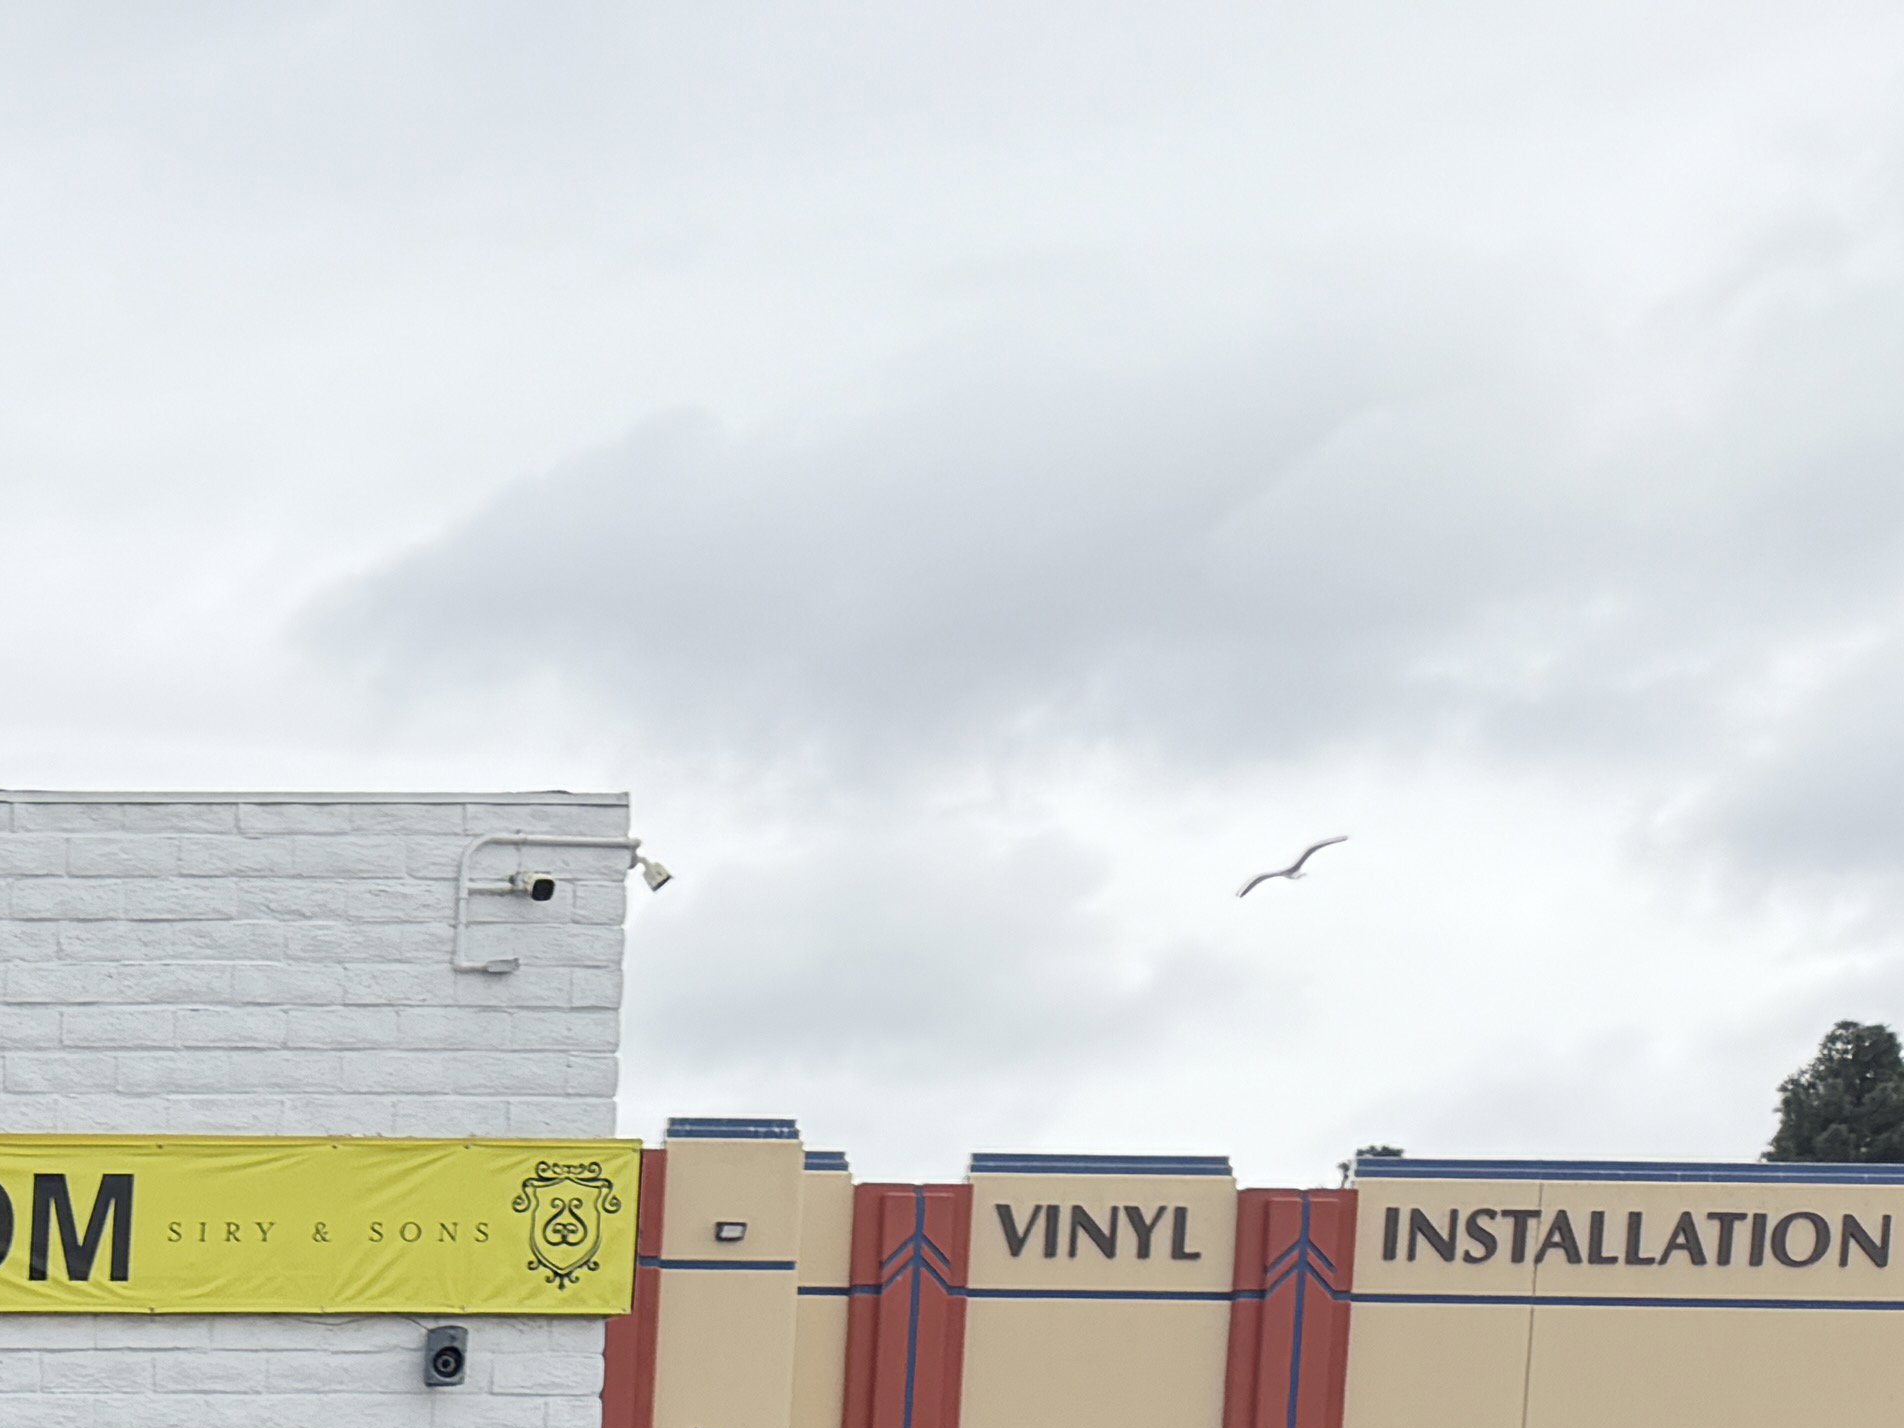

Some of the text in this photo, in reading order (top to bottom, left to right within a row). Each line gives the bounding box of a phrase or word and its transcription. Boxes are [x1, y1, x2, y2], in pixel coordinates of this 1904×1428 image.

[167, 1221, 490, 1244] SIRY & SONS
[994, 1202, 1201, 1260] VINYL
[1381, 1205, 1893, 1268] INSTALLATION
